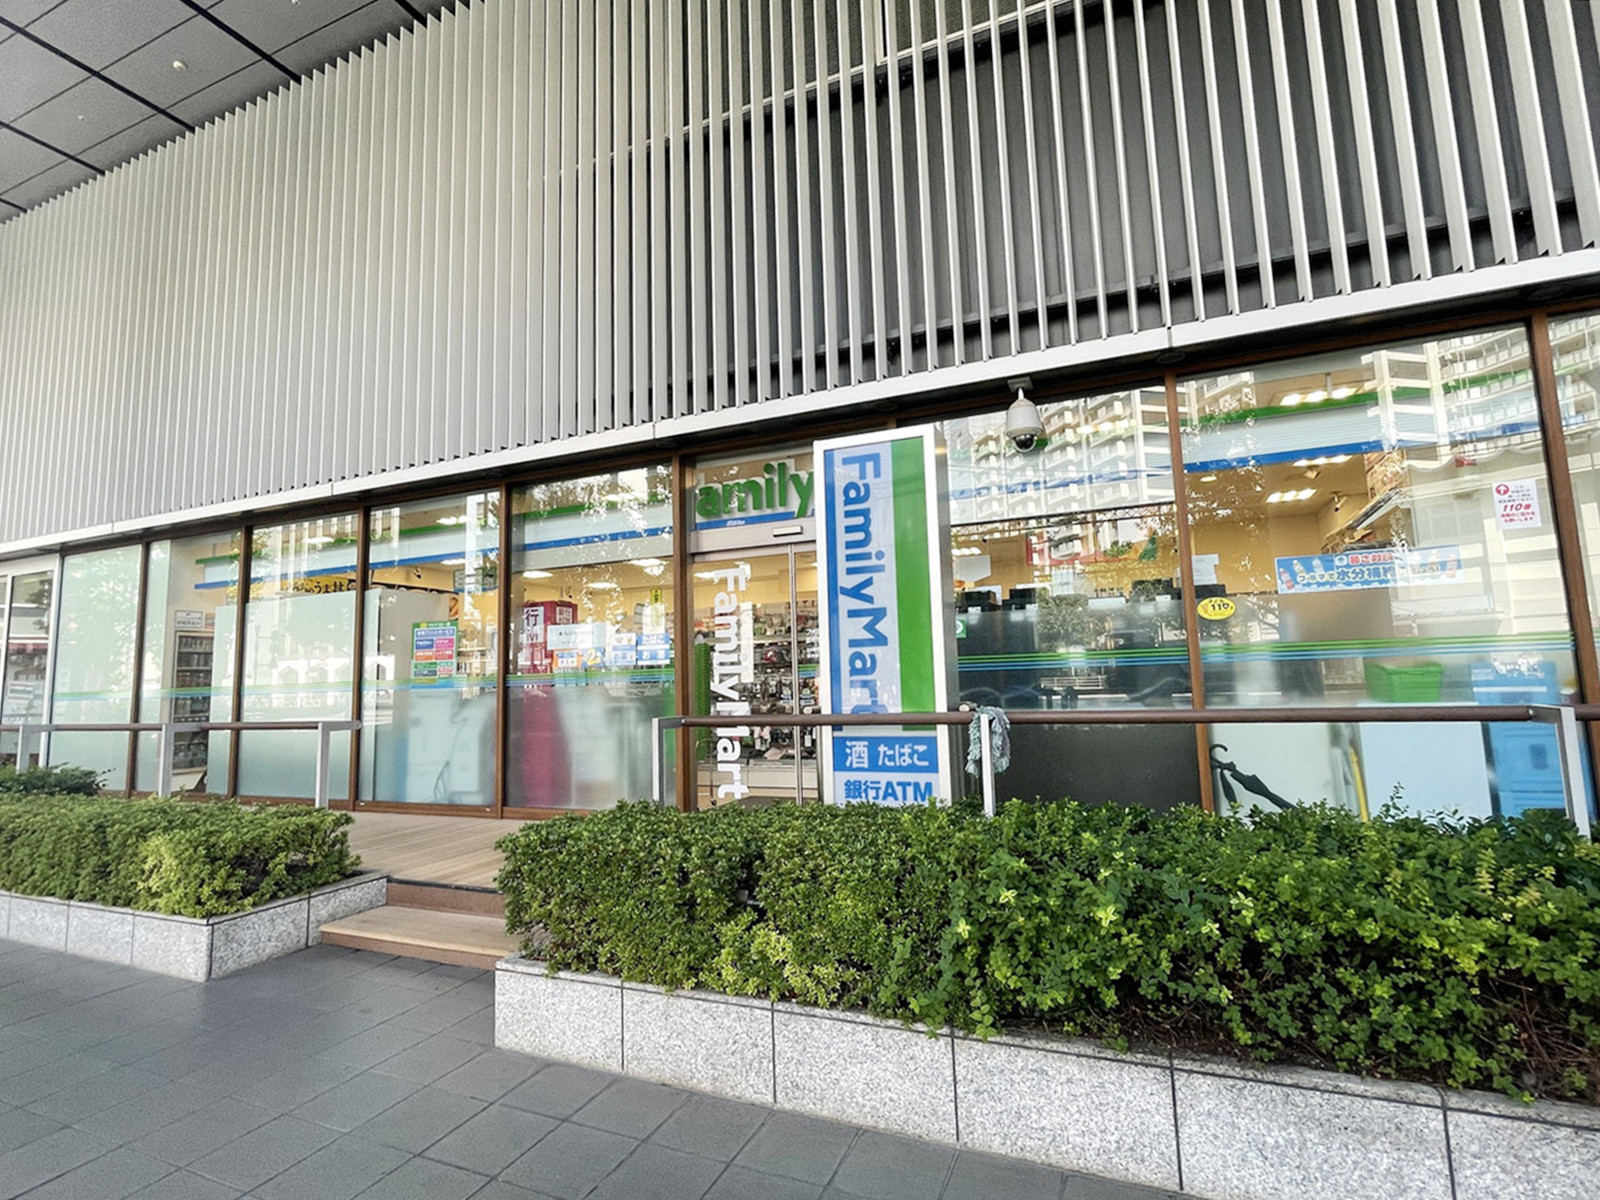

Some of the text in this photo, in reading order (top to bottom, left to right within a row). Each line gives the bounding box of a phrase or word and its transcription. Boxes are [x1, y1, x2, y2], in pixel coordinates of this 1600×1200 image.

[845, 740, 929, 768] 酒 たばこ
[844, 779, 933, 802] 銀行ATM
